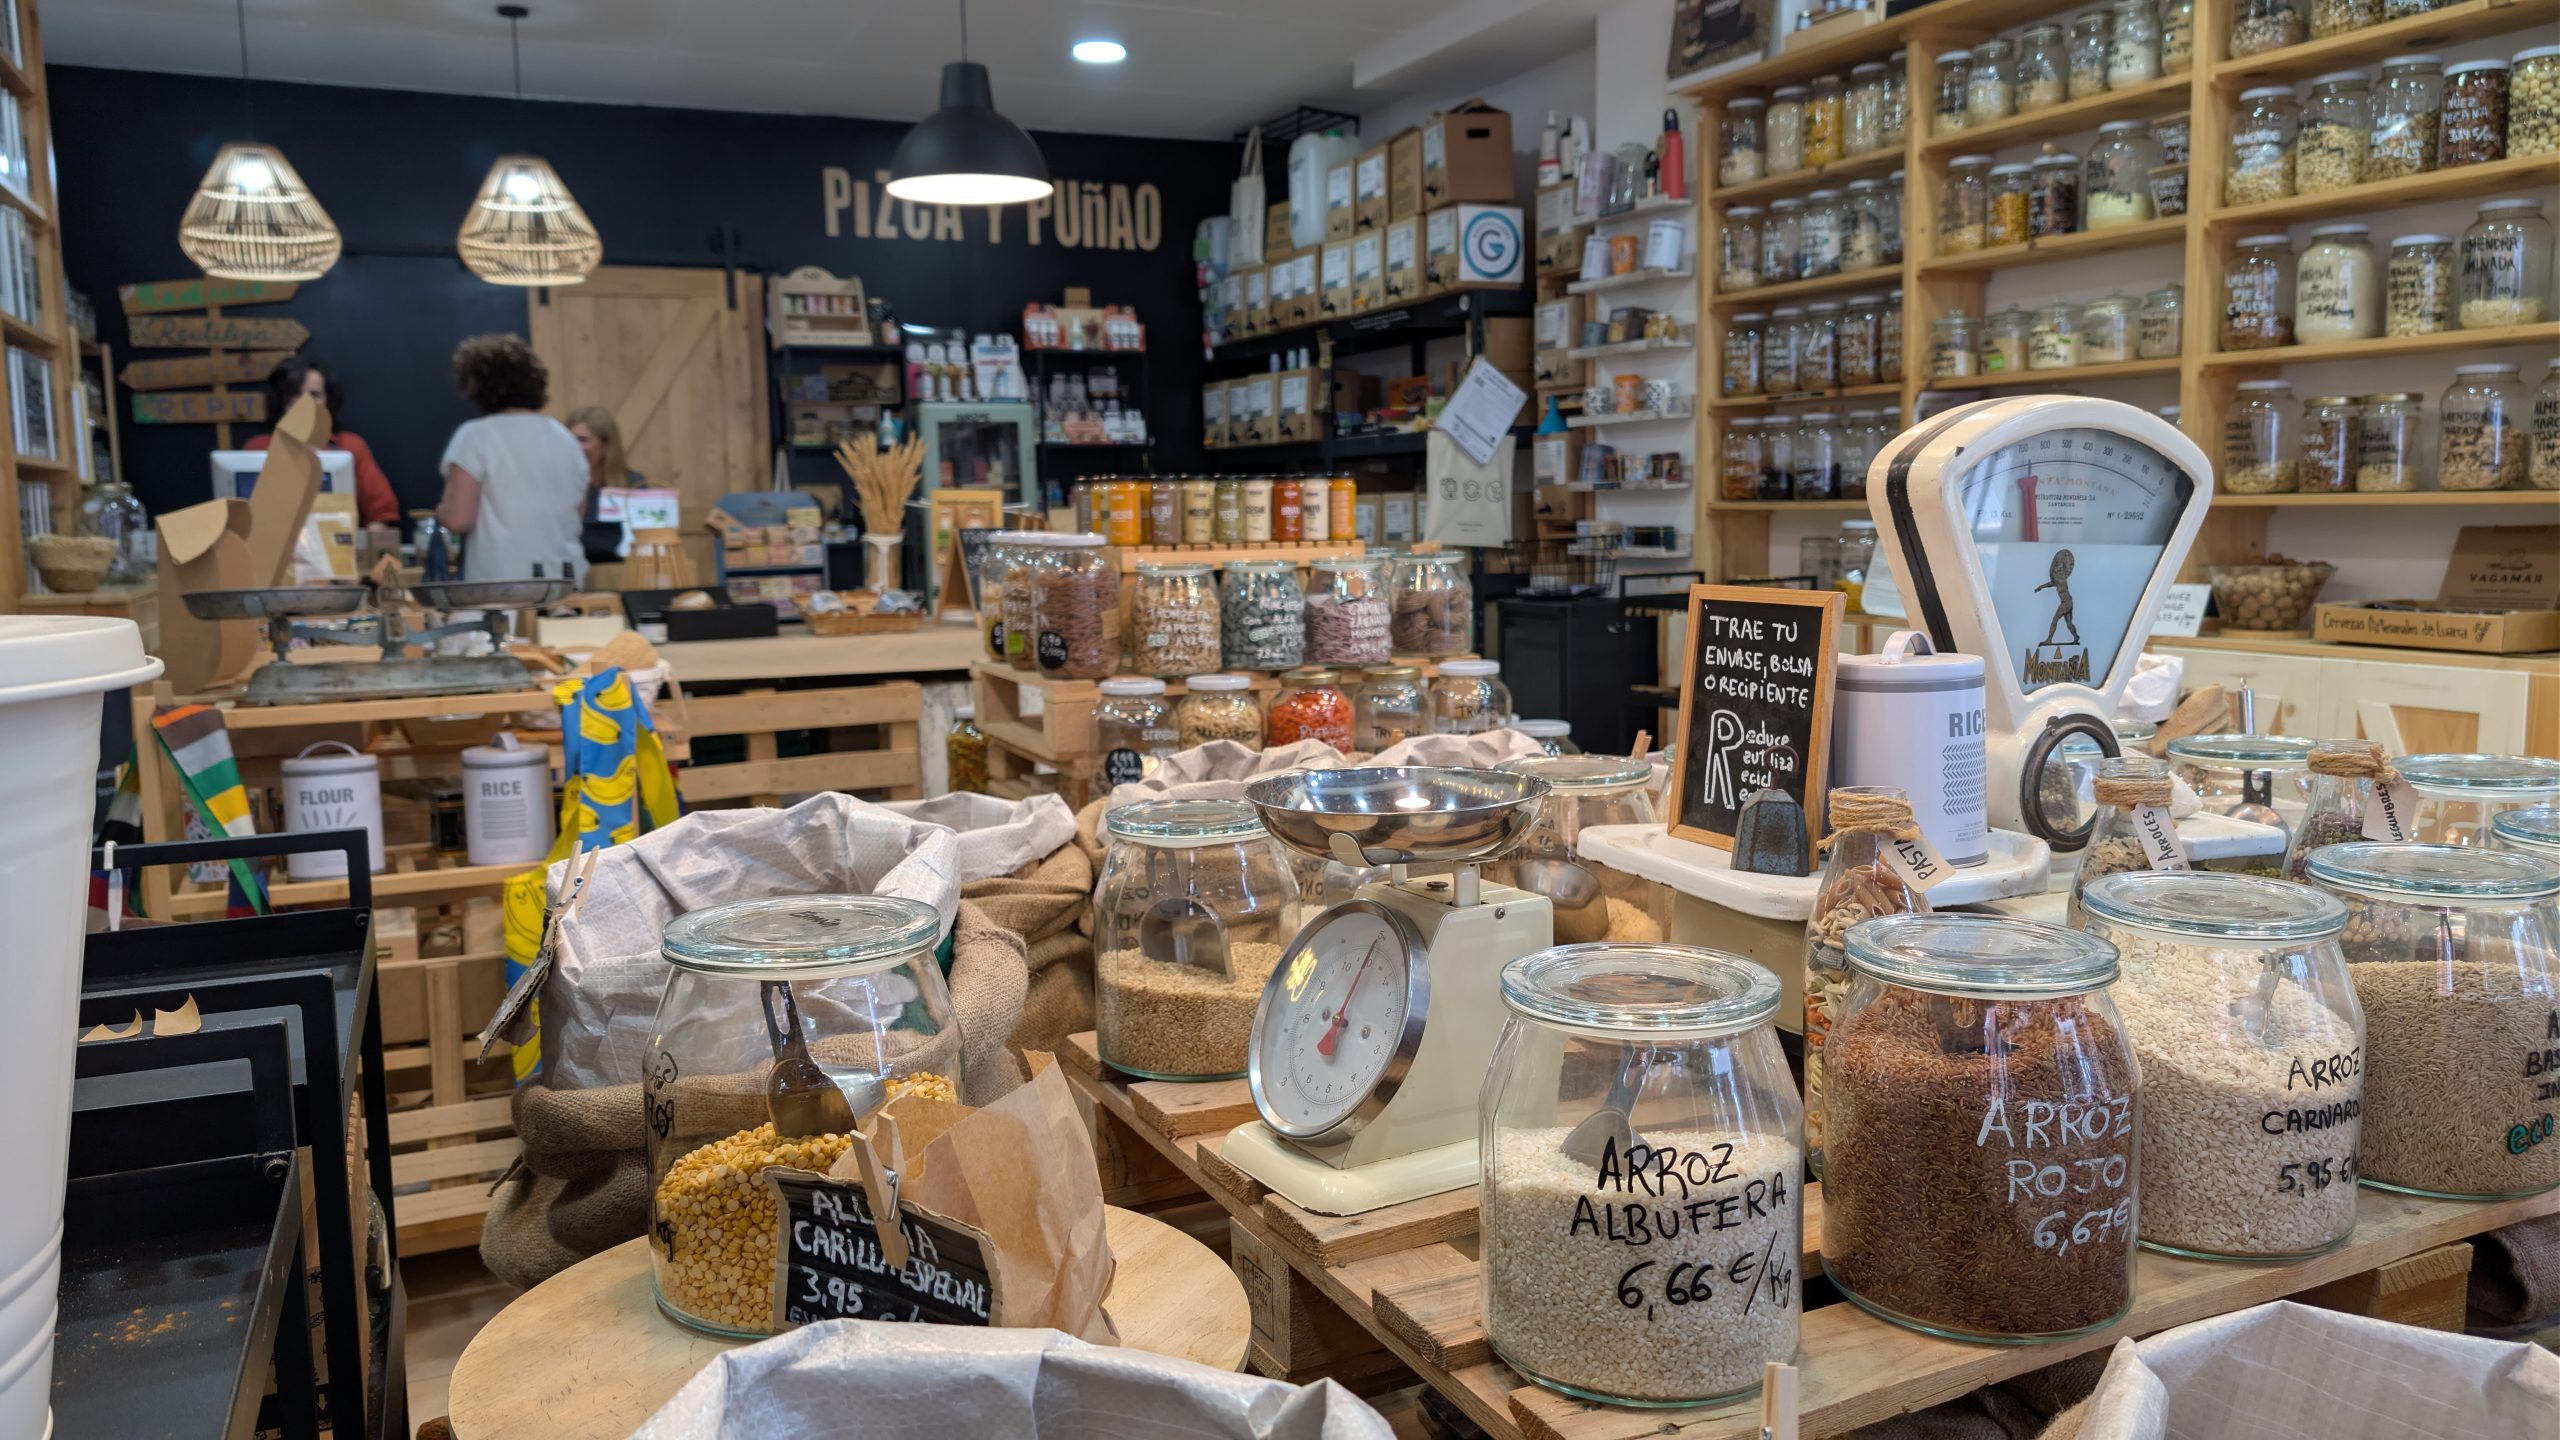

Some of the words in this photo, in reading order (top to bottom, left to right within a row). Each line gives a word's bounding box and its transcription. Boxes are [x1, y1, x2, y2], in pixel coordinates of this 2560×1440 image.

[2061, 439, 2072, 449] 500
[2102, 446, 2114, 456] 300
[1710, 615, 1764, 640] TRAE
[1772, 621, 1798, 642] TU
[2422, 621, 2435, 636] de
[1770, 654, 1813, 677] BOLSA
[1704, 673, 1716, 690] O
[1742, 750, 1795, 773] eutliza
[299, 787, 355, 806] FLOUR
[481, 780, 523, 797] RICE
[2142, 810, 2178, 862] ARROCES
[1302, 1013, 1311, 1024] 8
[1384, 1007, 1393, 1018] 2
[2287, 1046, 2361, 1091] ARROZ
[1325, 1083, 1333, 1094] 5
[1976, 1094, 2132, 1149] ARROZ
[2506, 1112, 2555, 1156] eco
[1597, 1135, 1739, 1200] ARROZ
[2004, 1153, 2127, 1203] ROJO
[1569, 1171, 1787, 1246] ALBUFERA
[801, 1265, 864, 1315] 3,95
[1617, 1260, 1714, 1322] 6,66
